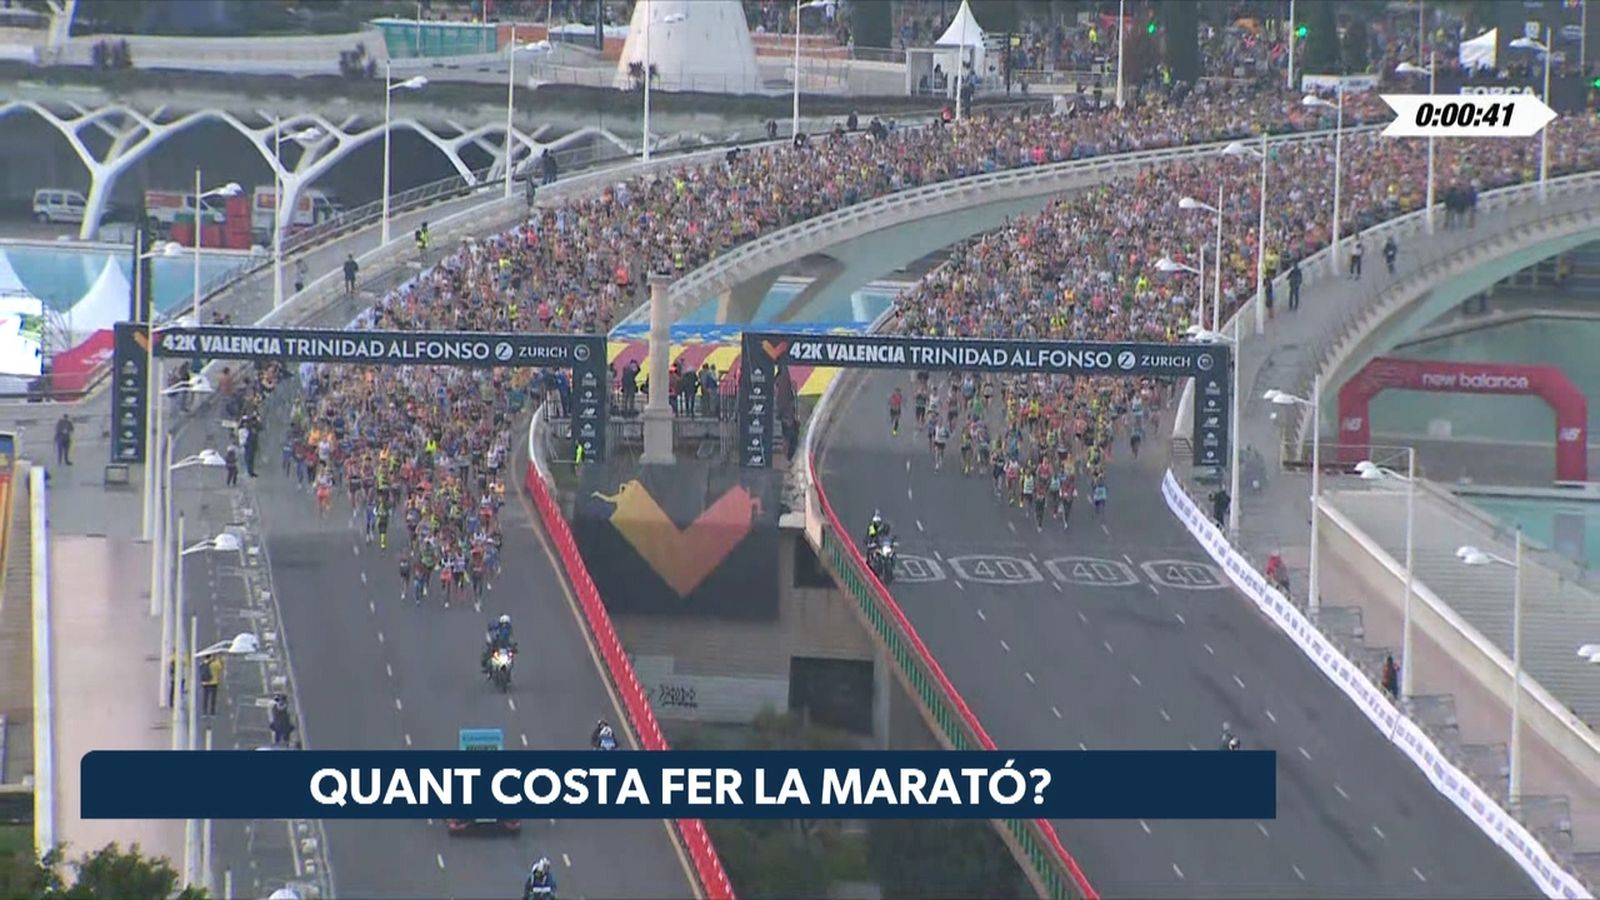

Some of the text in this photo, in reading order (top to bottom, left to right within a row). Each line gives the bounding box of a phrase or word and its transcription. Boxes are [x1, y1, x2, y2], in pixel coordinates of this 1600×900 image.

[162, 333, 490, 361] 42K VALENCIA TRINIDAD ALFONSO
[518, 345, 568, 359] ZURICH
[789, 342, 1113, 369] 42K VALENCIA TRINIDAD ALFONSO
[1141, 354, 1192, 369] ZURICH
[1422, 373, 1529, 389] new balance
[973, 560, 1019, 580] 40
[1071, 561, 1118, 581] 40
[1165, 565, 1213, 585] 40
